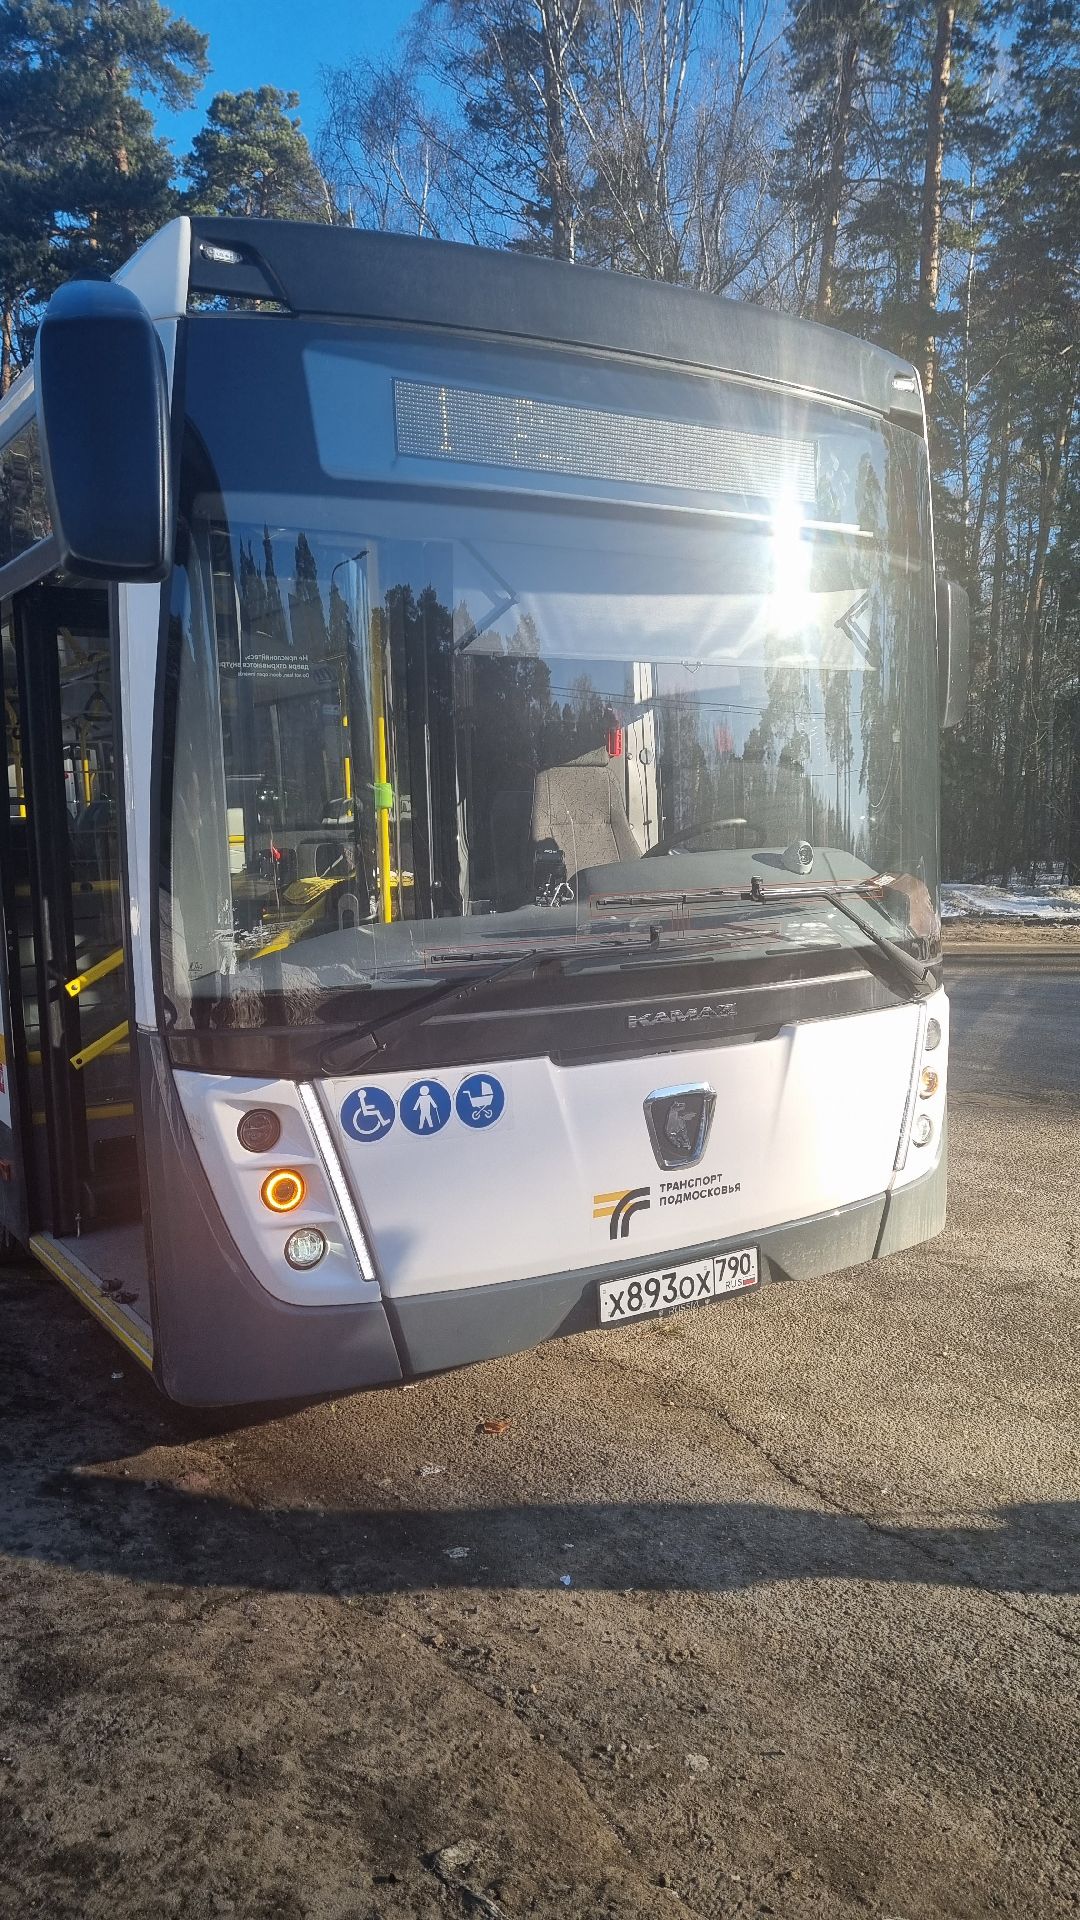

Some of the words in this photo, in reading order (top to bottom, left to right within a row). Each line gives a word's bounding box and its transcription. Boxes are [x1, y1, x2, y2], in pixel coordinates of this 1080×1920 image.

[660, 1174, 723, 1192] ТРАНСПОРТ
[660, 1183, 741, 1206] ПОДМОСКОВЬЯ
[715, 1253, 751, 1281] 790
[726, 1278, 742, 1290] RUS
